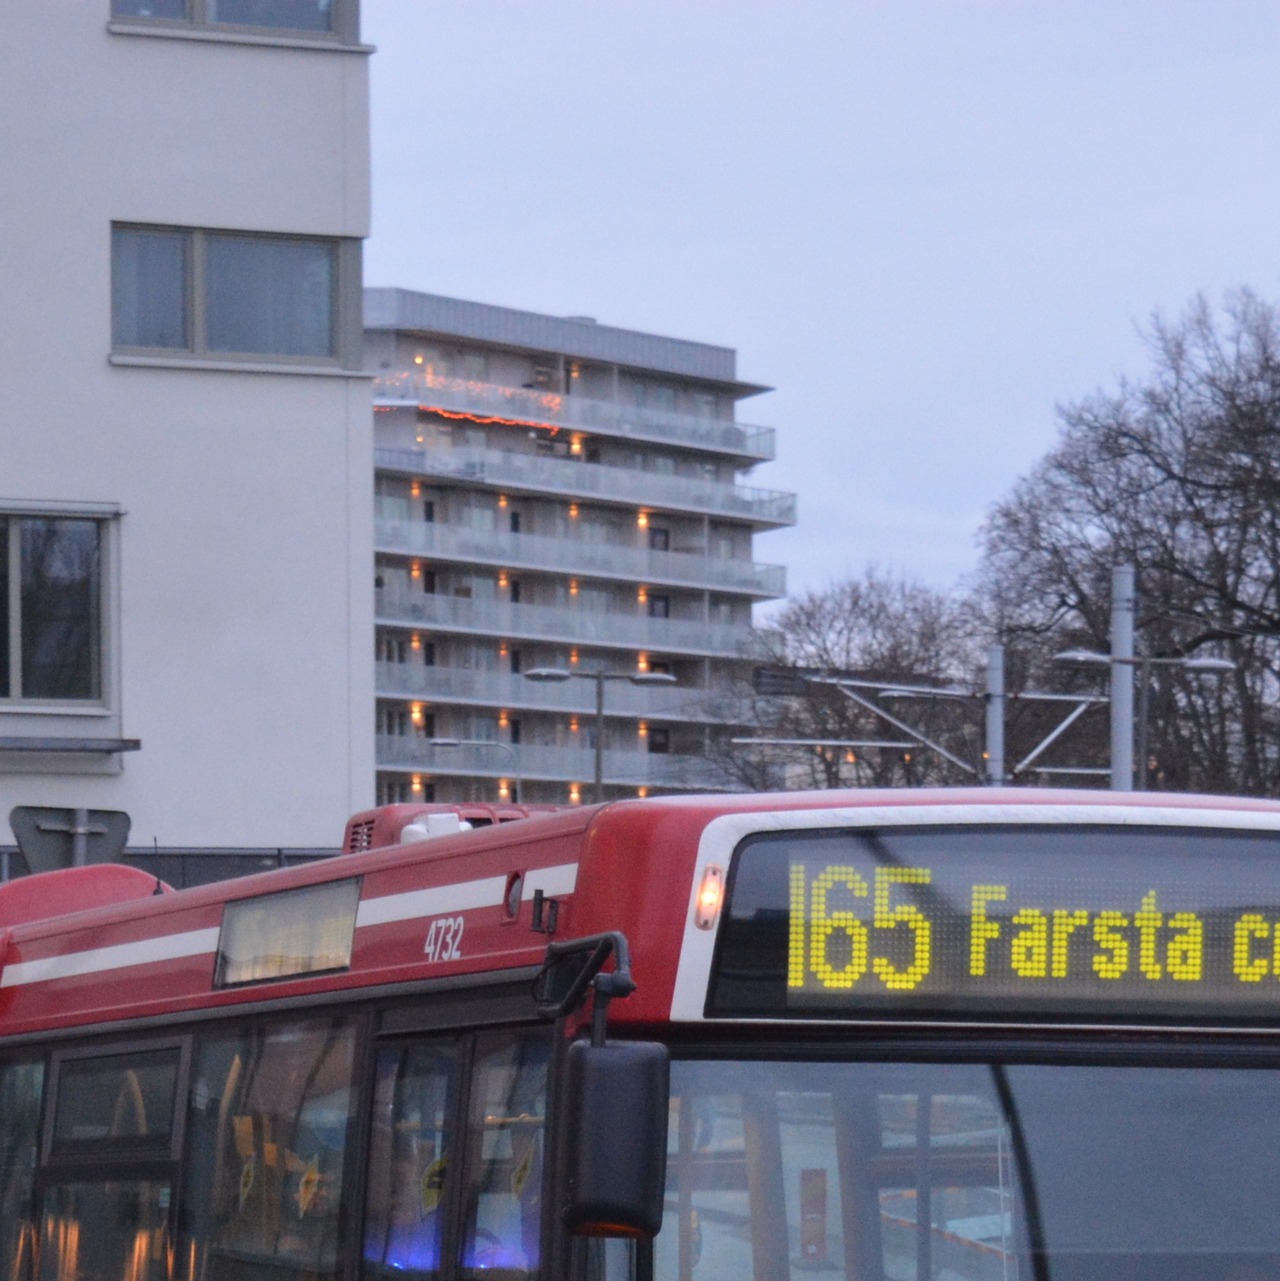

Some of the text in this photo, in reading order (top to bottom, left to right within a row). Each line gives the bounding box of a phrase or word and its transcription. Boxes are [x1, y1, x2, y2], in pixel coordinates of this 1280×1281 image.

[424, 916, 464, 962] 4732
[787, 865, 932, 989] 165
[970, 885, 1203, 981] Farsta
